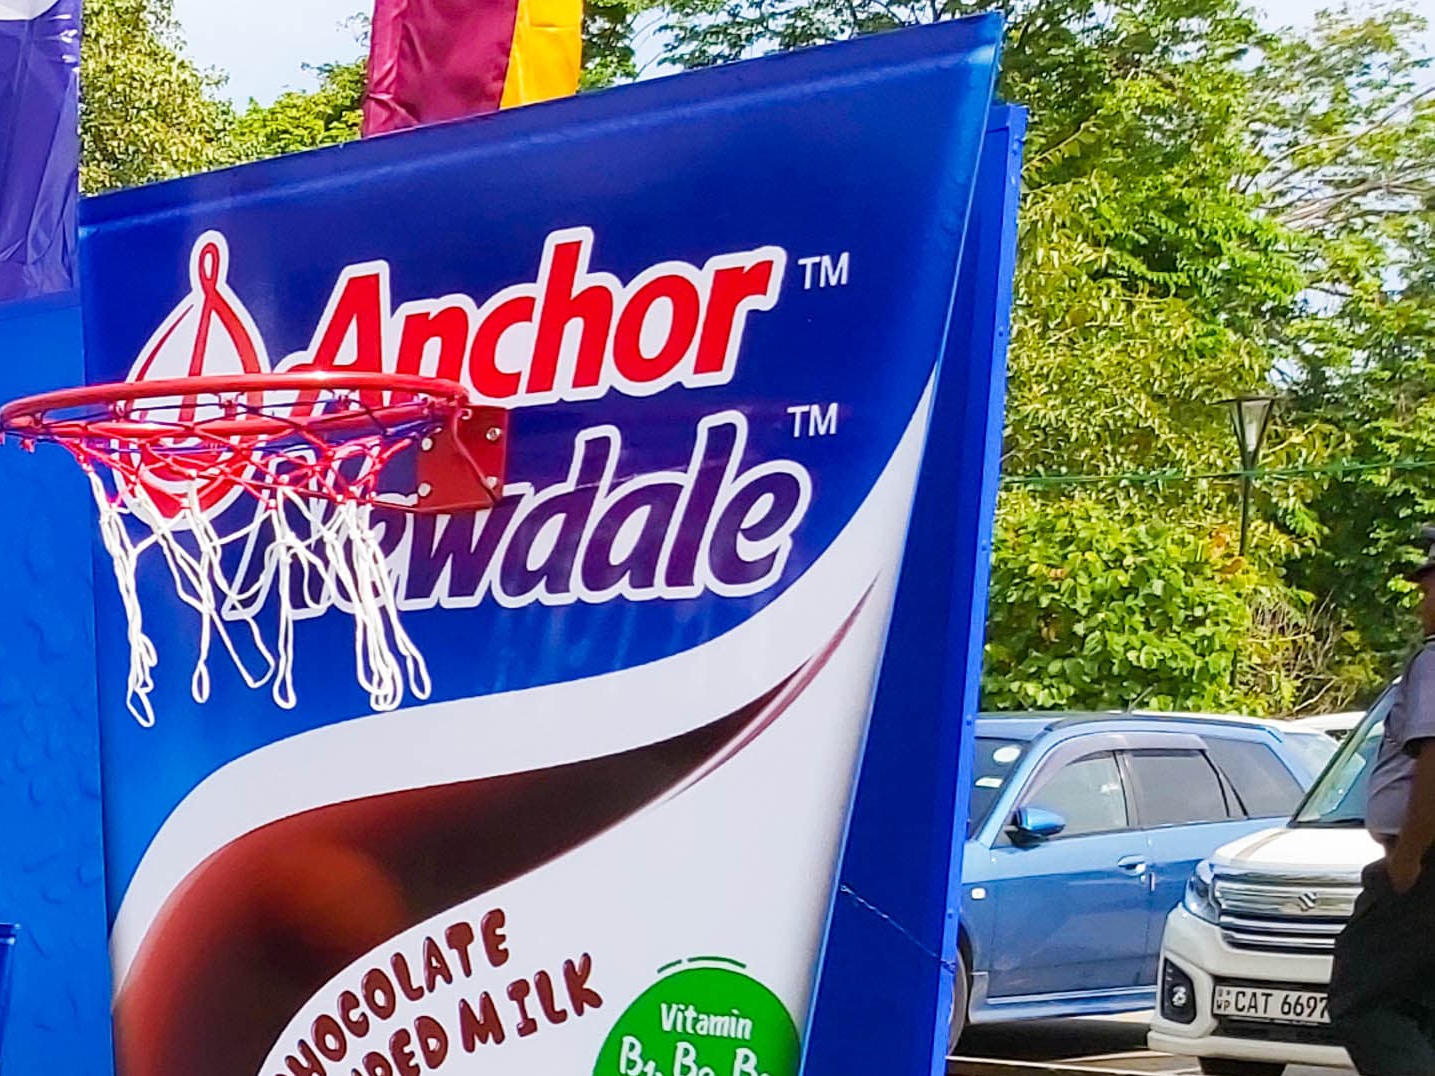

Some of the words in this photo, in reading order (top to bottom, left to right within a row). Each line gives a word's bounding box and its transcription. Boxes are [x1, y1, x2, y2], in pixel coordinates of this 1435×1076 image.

[274, 225, 788, 424] Anchor
[459, 952, 603, 1053] MILK
[660, 1002, 753, 1040] Vitamin
[1234, 991, 1273, 1014] CAT
[1280, 994, 1328, 1018] 6697
